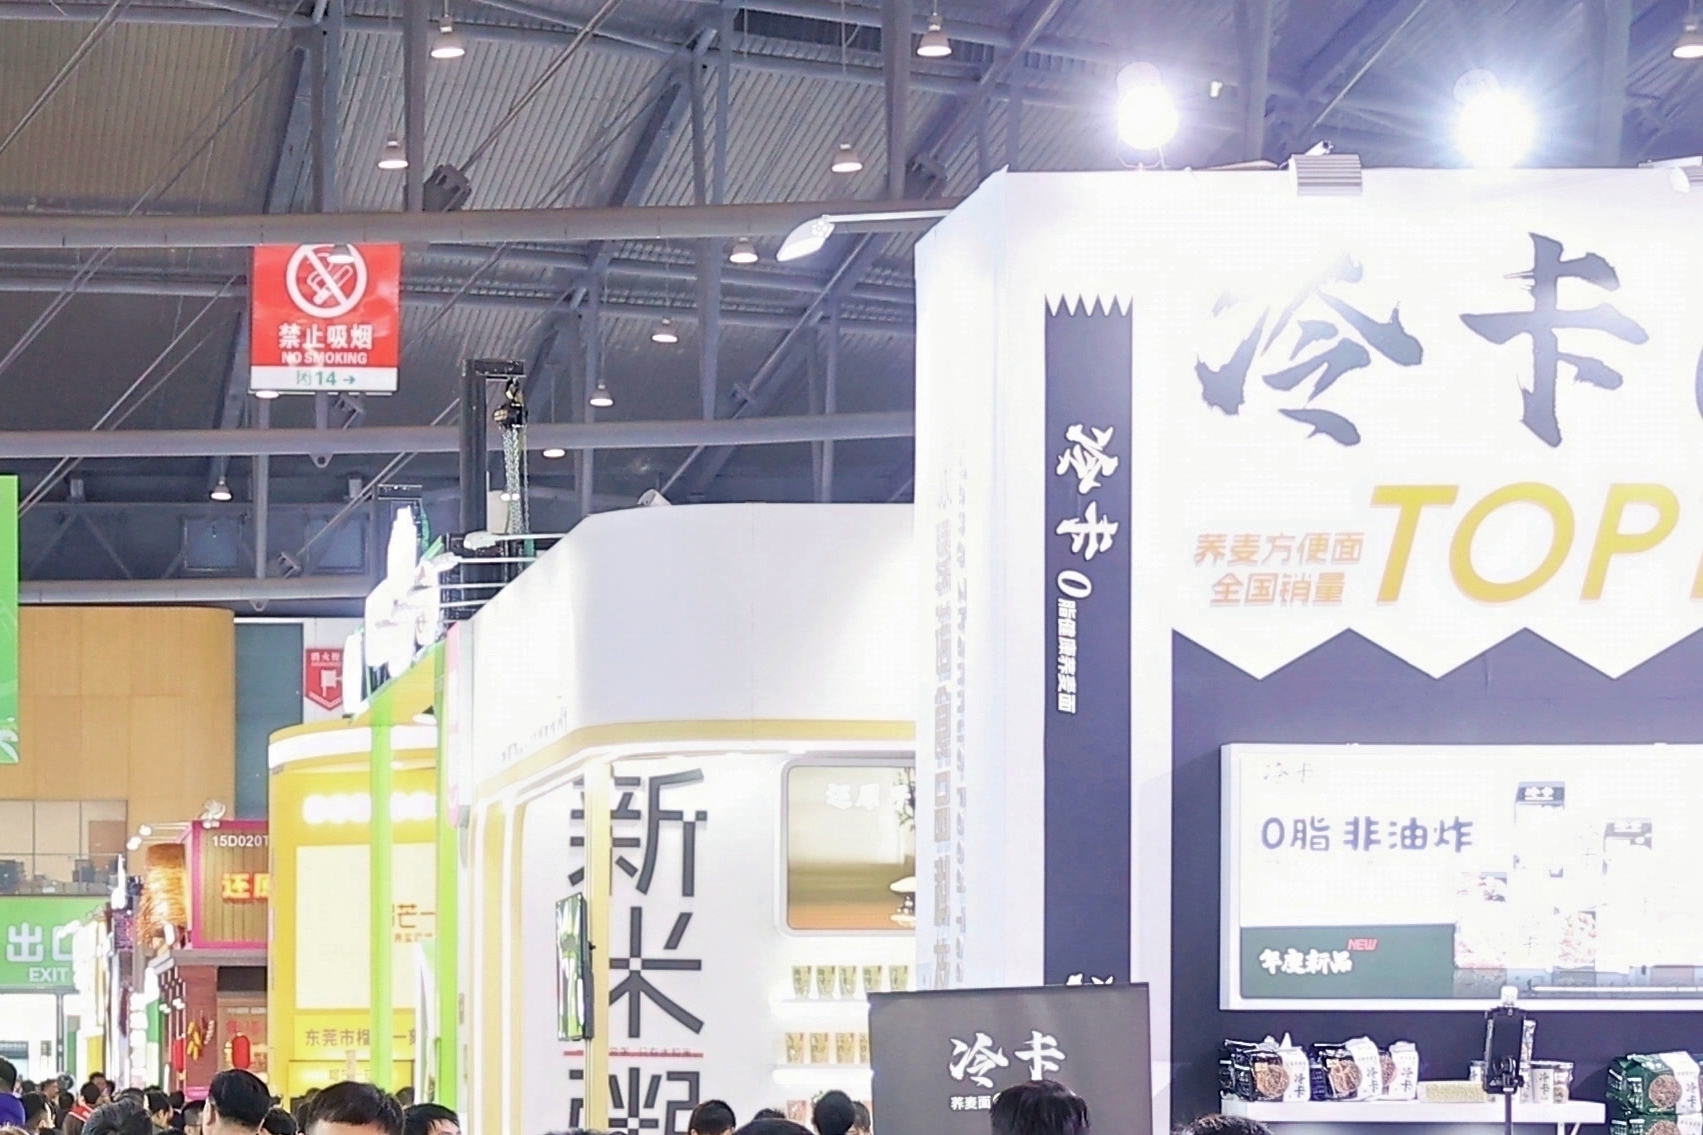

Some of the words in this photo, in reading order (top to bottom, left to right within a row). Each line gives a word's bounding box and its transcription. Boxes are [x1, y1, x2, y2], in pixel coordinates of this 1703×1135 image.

[279, 323, 373, 350] 禁止吸烟
[1194, 232, 1650, 448] 冷卡
[282, 352, 302, 364] NO
[304, 352, 367, 364] SMOKING
[1193, 530, 1364, 566] 荞麦方便面
[1368, 480, 1703, 604] TOP
[1210, 572, 1345, 607] 全国销量
[1261, 816, 1330, 851] 0脂
[1342, 816, 1474, 853] 非油炸
[7, 922, 74, 963] 出口
[1347, 938, 1378, 951] NEW
[29, 967, 69, 982] EXIT
[1259, 948, 1352, 976] 年度新品
[305, 1028, 416, 1047] 东莞市榴一
[947, 1030, 1066, 1089] 冷卡
[950, 1092, 1001, 1111] 荞麦面
